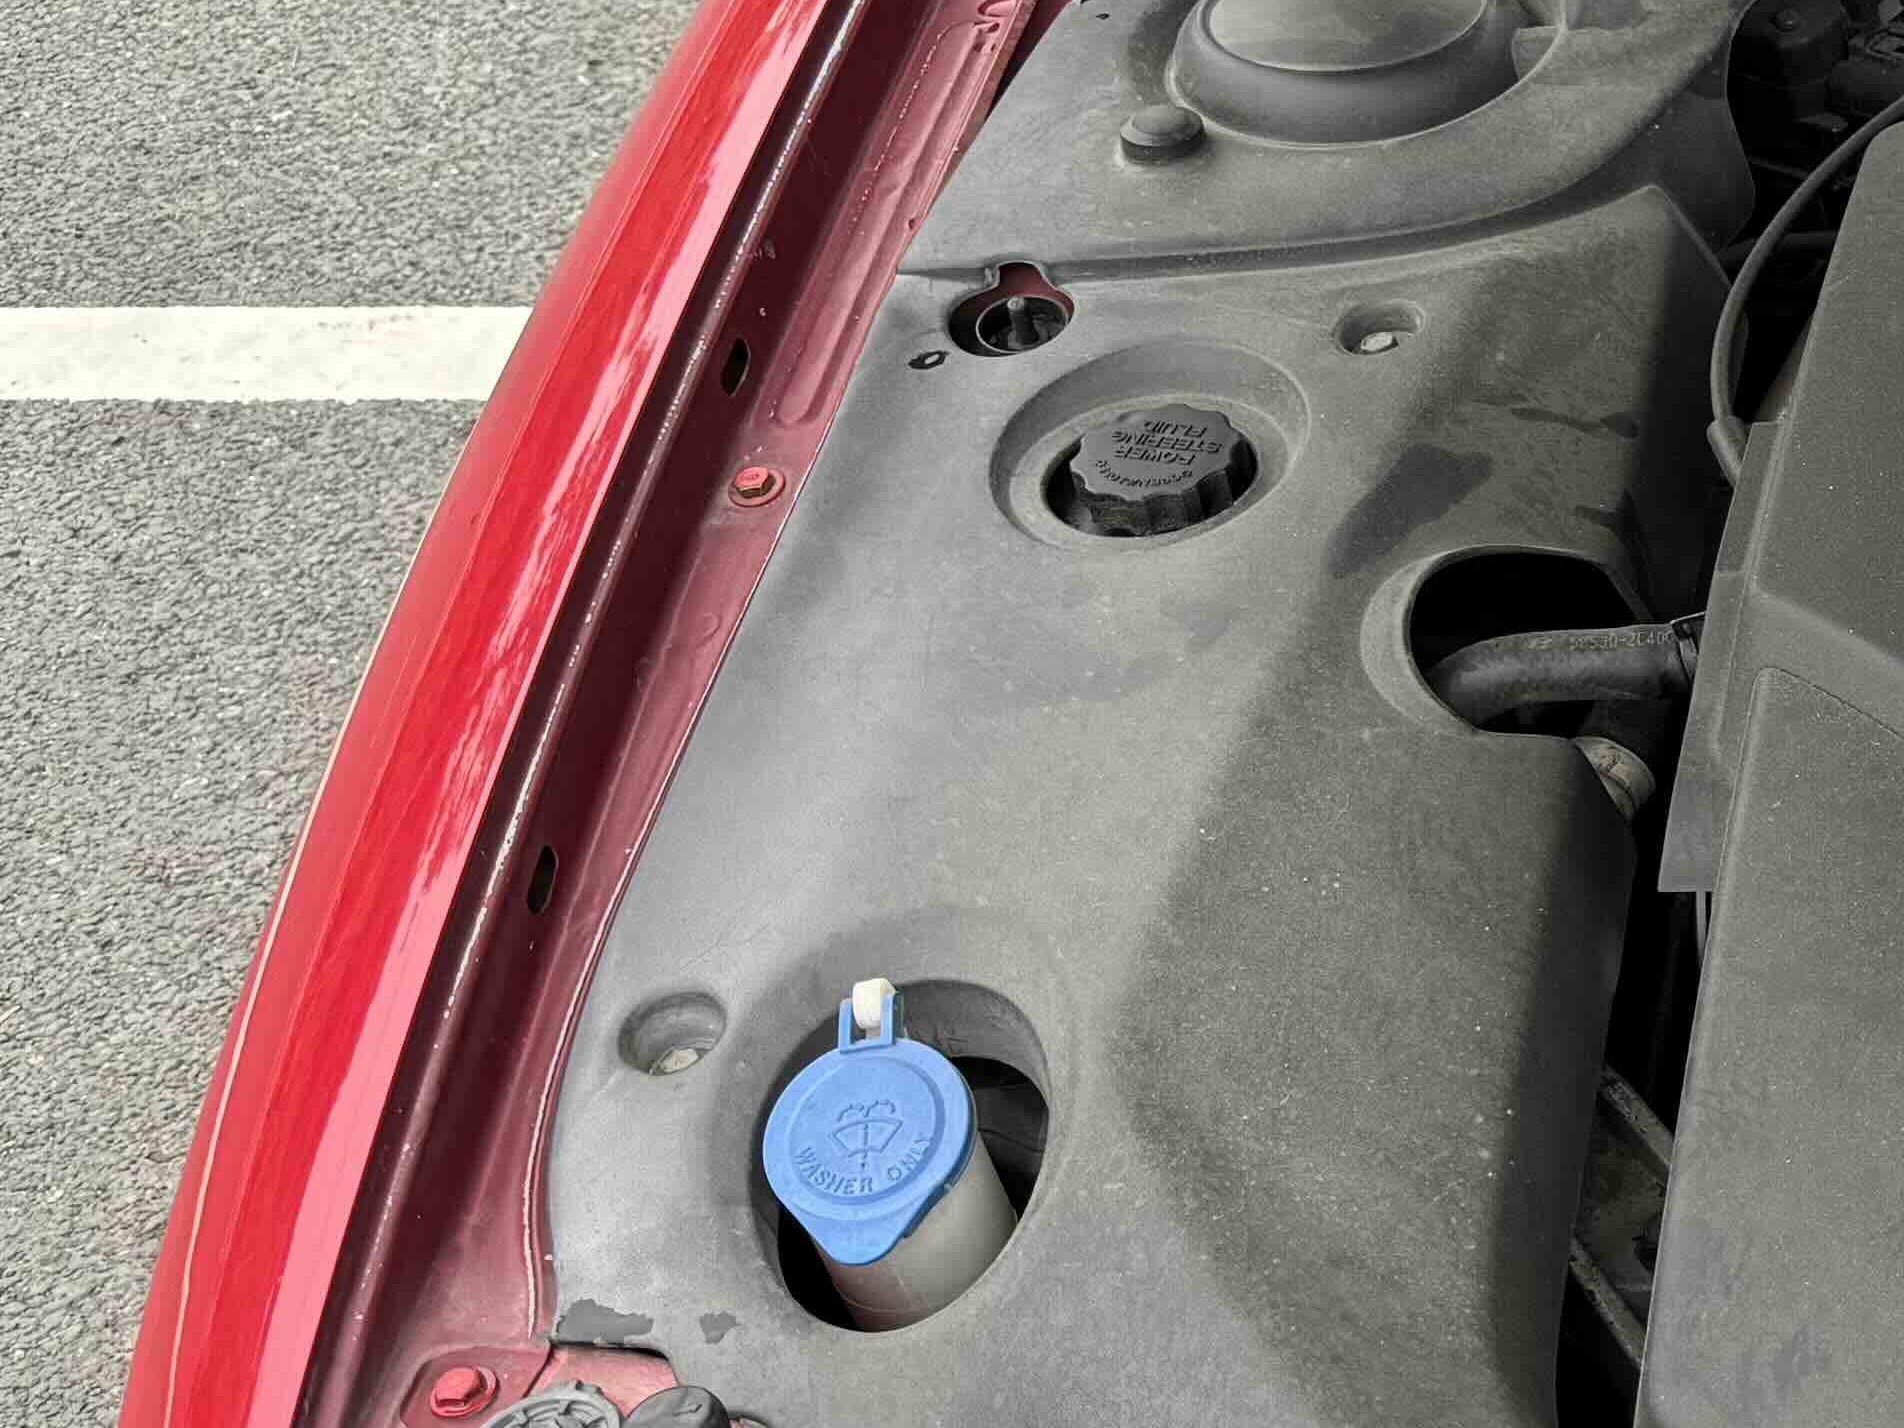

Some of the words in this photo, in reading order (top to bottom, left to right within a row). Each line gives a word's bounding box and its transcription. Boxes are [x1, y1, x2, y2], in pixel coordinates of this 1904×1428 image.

[1143, 421, 1208, 439] FLUID
[1111, 431, 1223, 455] STEERING
[1113, 446, 1196, 467] POWER
[793, 1145, 874, 1196] WASHER
